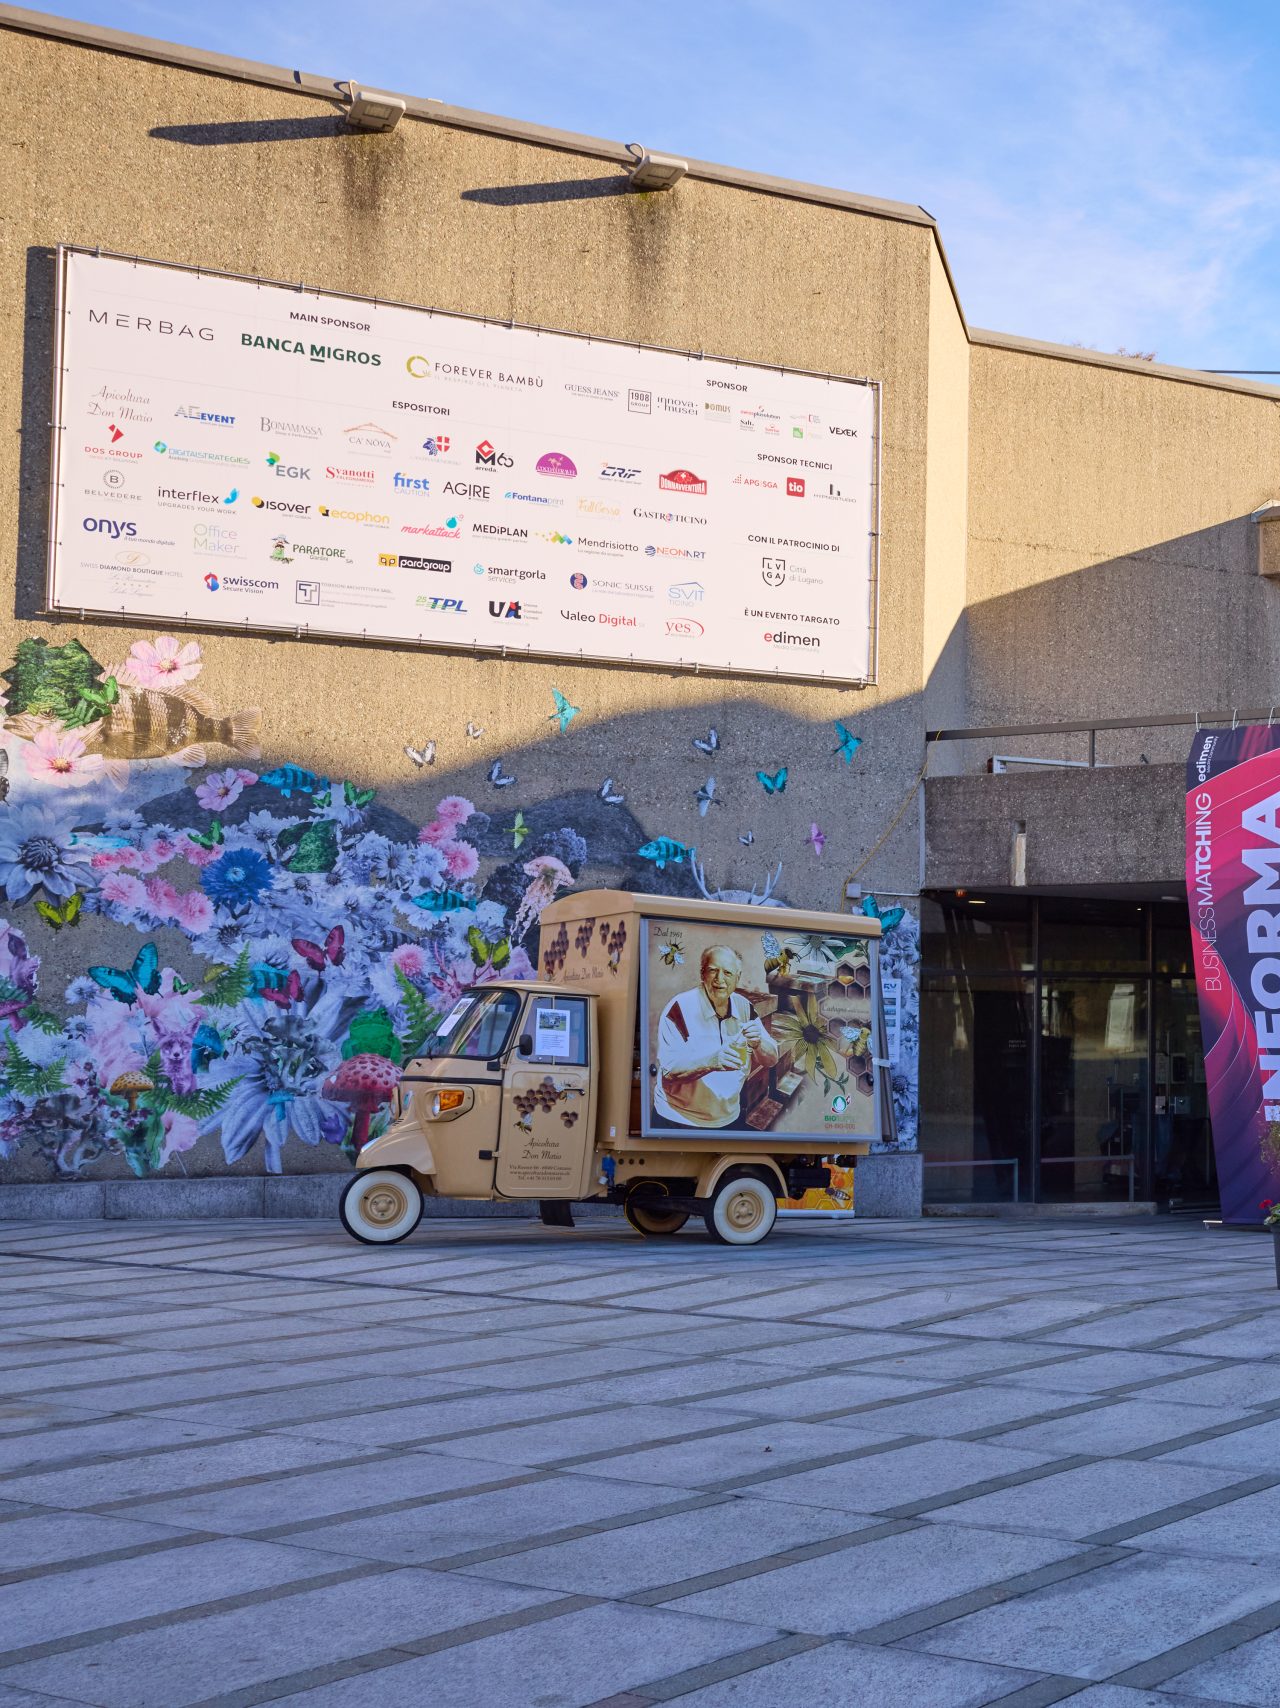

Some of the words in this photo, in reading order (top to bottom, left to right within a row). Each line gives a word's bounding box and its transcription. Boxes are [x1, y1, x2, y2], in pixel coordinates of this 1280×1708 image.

[88, 309, 215, 342] MERBAG
[289, 311, 318, 325] MAIN
[320, 315, 371, 332] SPONSOR
[240, 333, 305, 356] BANCA
[310, 344, 382, 367] MIGROS
[434, 362, 492, 380] FOREVER
[498, 372, 544, 388] BAMBÙ
[564, 384, 593, 394] GUESS
[592, 387, 619, 398] JEANS
[706, 379, 748, 393] SPONSOR
[91, 385, 151, 405] Apicoltura
[631, 392, 650, 402] 1908
[86, 402, 115, 419] Don
[118, 405, 153, 423] Mario
[392, 400, 451, 416] ESPOSITORI
[829, 426, 858, 438] VEXEK
[84, 446, 105, 455] DOS
[108, 449, 143, 459] GROUP
[757, 453, 798, 466] SPONSOR
[799, 459, 833, 471] TECNICI
[109, 475, 119, 484] B
[275, 465, 311, 481] EGK
[325, 465, 375, 480] Svanotti
[393, 472, 430, 491] first
[788, 481, 804, 493] tio
[84, 488, 143, 501] BELVEDERE
[157, 486, 219, 504] interflex
[442, 481, 491, 500] AGIRE
[266, 500, 311, 514] isover
[330, 508, 390, 525] ecophon
[82, 517, 137, 539] onys
[193, 523, 238, 540] Office
[400, 524, 461, 540] markattack
[193, 537, 240, 554] Maker
[577, 537, 639, 552] Mendrisiotto
[747, 534, 768, 544] CON
[769, 537, 776, 545] IL
[777, 538, 830, 551] PATROCINIO
[831, 544, 840, 552] DI
[292, 544, 346, 559] PARATORE
[99, 564, 132, 573] DIAMOND
[222, 575, 279, 590] swisscom
[222, 584, 243, 593] Secure
[592, 579, 622, 589] SONIC
[624, 582, 655, 592] SUISSE
[668, 587, 704, 601] SVIT
[428, 596, 468, 612] TPL
[560, 609, 596, 624] Valeo
[598, 613, 637, 627] Digital
[744, 607, 749, 616] È
[750, 610, 763, 618] UN
[764, 611, 799, 621] EVENTO
[799, 614, 840, 626] TARGATO
[665, 621, 692, 636] yes
[763, 631, 821, 648] edimen
[1196, 736, 1214, 782] edimen
[524, 1137, 560, 1149] Apicoltura
[521, 1149, 539, 1160] Don
[541, 1150, 562, 1160] Mario
